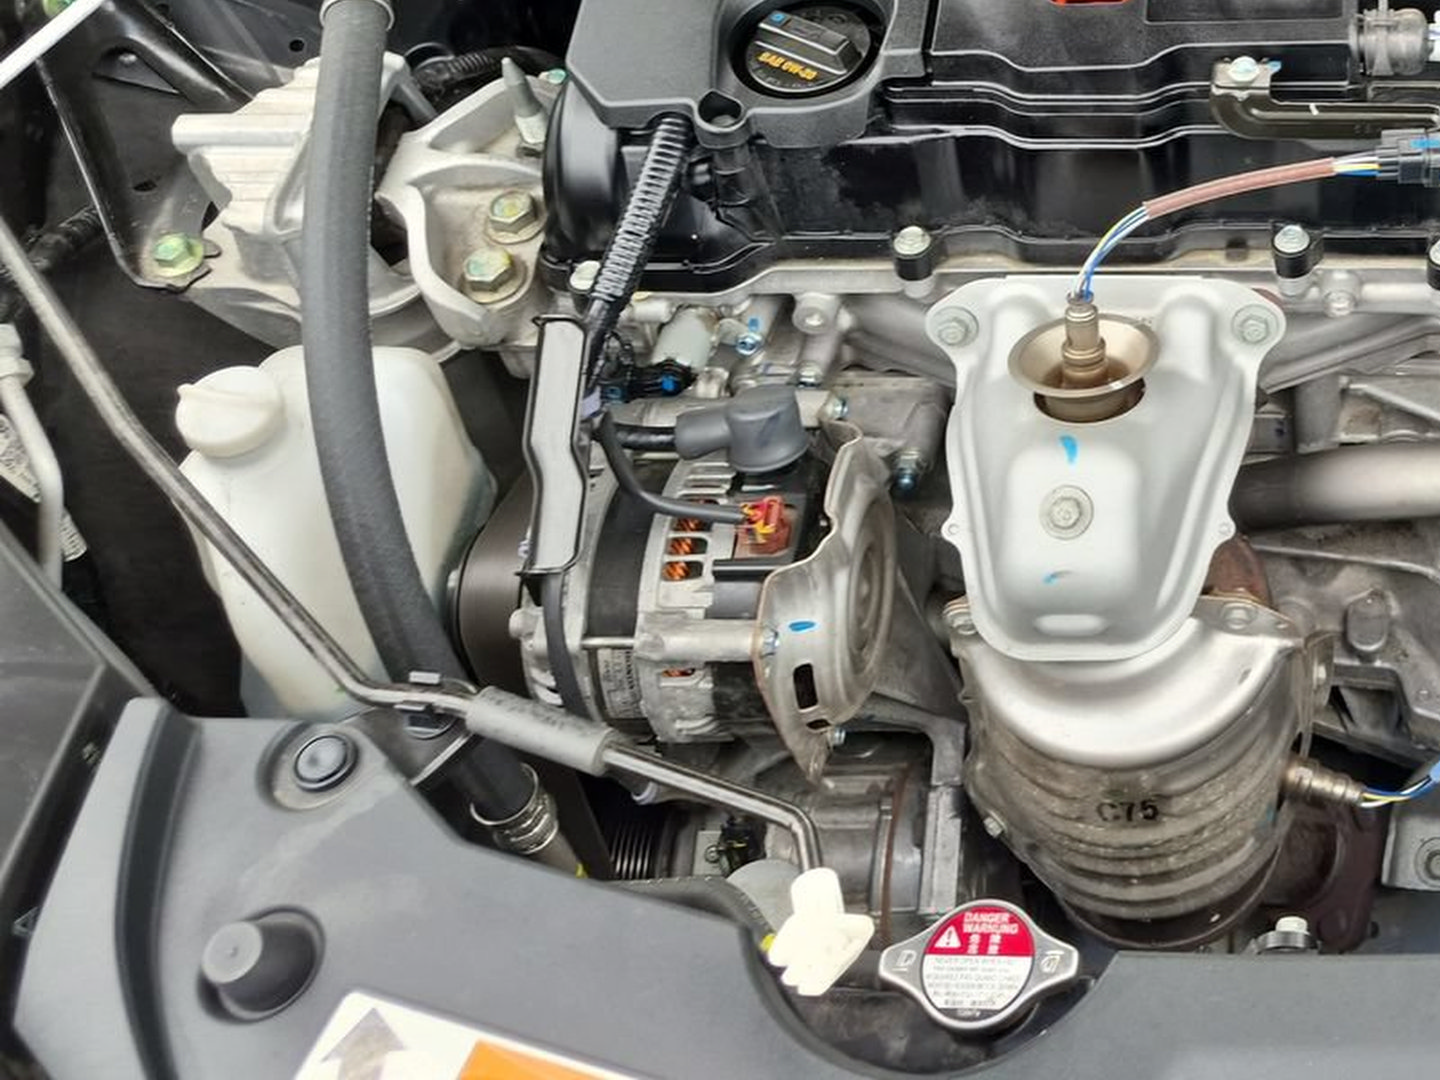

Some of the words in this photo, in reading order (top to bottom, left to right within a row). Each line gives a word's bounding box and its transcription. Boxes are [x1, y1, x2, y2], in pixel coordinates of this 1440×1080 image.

[1096, 799, 1160, 822] C75
[963, 912, 1011, 922] DANGER
[963, 922, 1019, 934] WARNING
